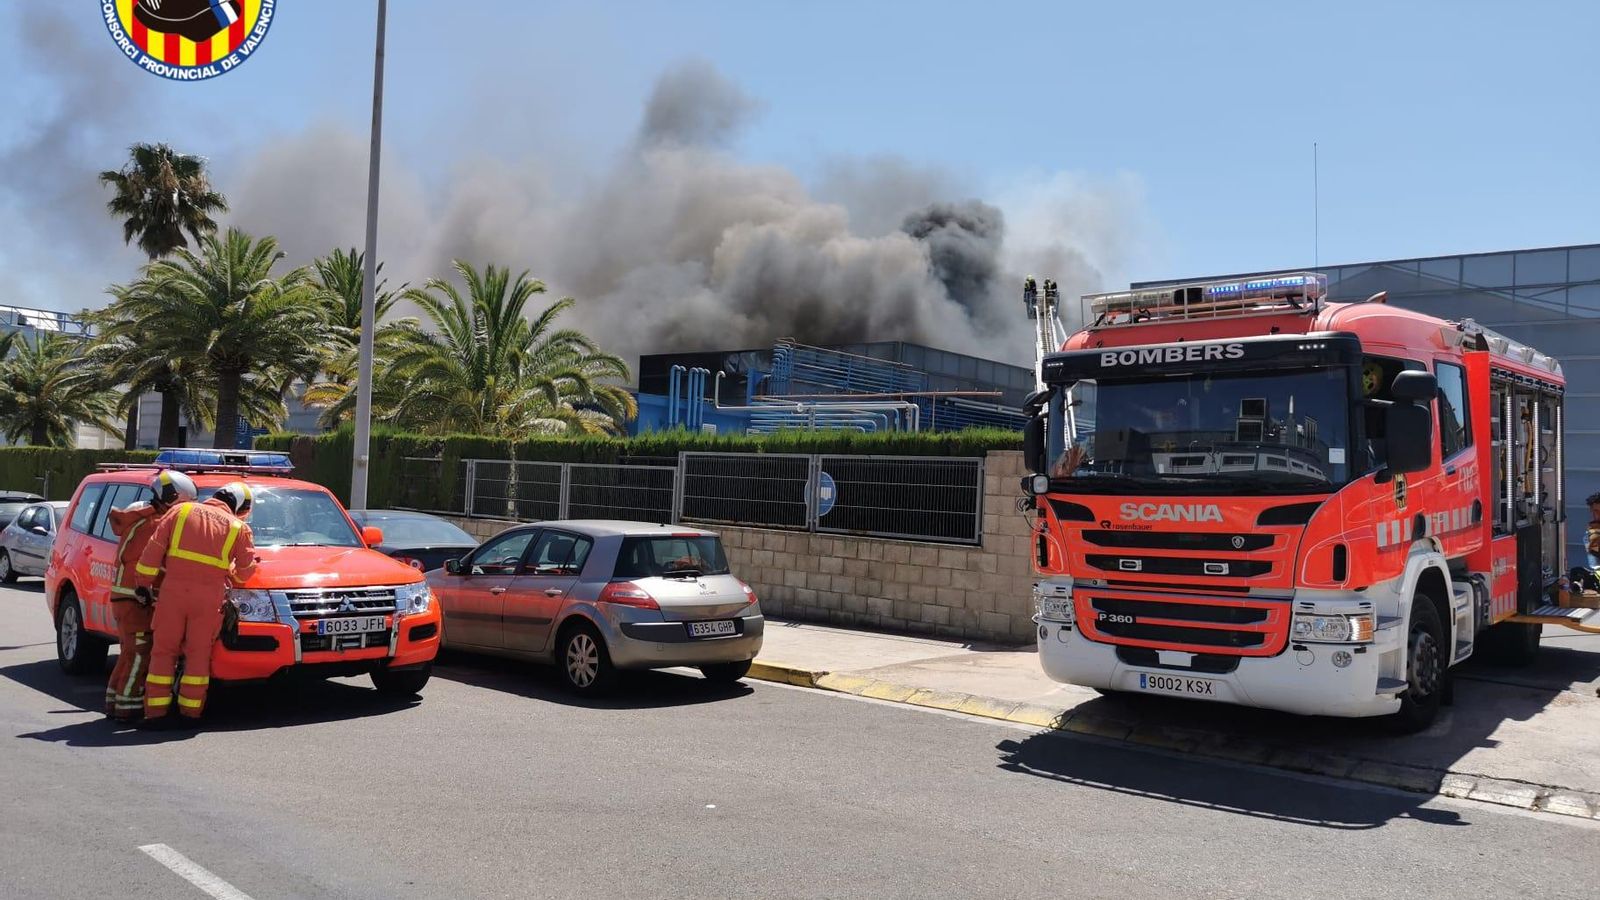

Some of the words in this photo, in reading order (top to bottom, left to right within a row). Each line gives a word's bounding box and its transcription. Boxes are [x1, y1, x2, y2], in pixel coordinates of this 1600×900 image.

[1100, 343, 1245, 367] BOMBERS
[1120, 503, 1223, 522] SCANIA
[326, 620, 358, 632] 6033
[362, 618, 384, 630] JFH
[1099, 613, 1107, 621] P
[1109, 614, 1133, 624] 360
[693, 623, 715, 634] 6354
[718, 621, 733, 632] GHP
[1149, 675, 1182, 691] 9002
[1187, 680, 1213, 694] KSX
